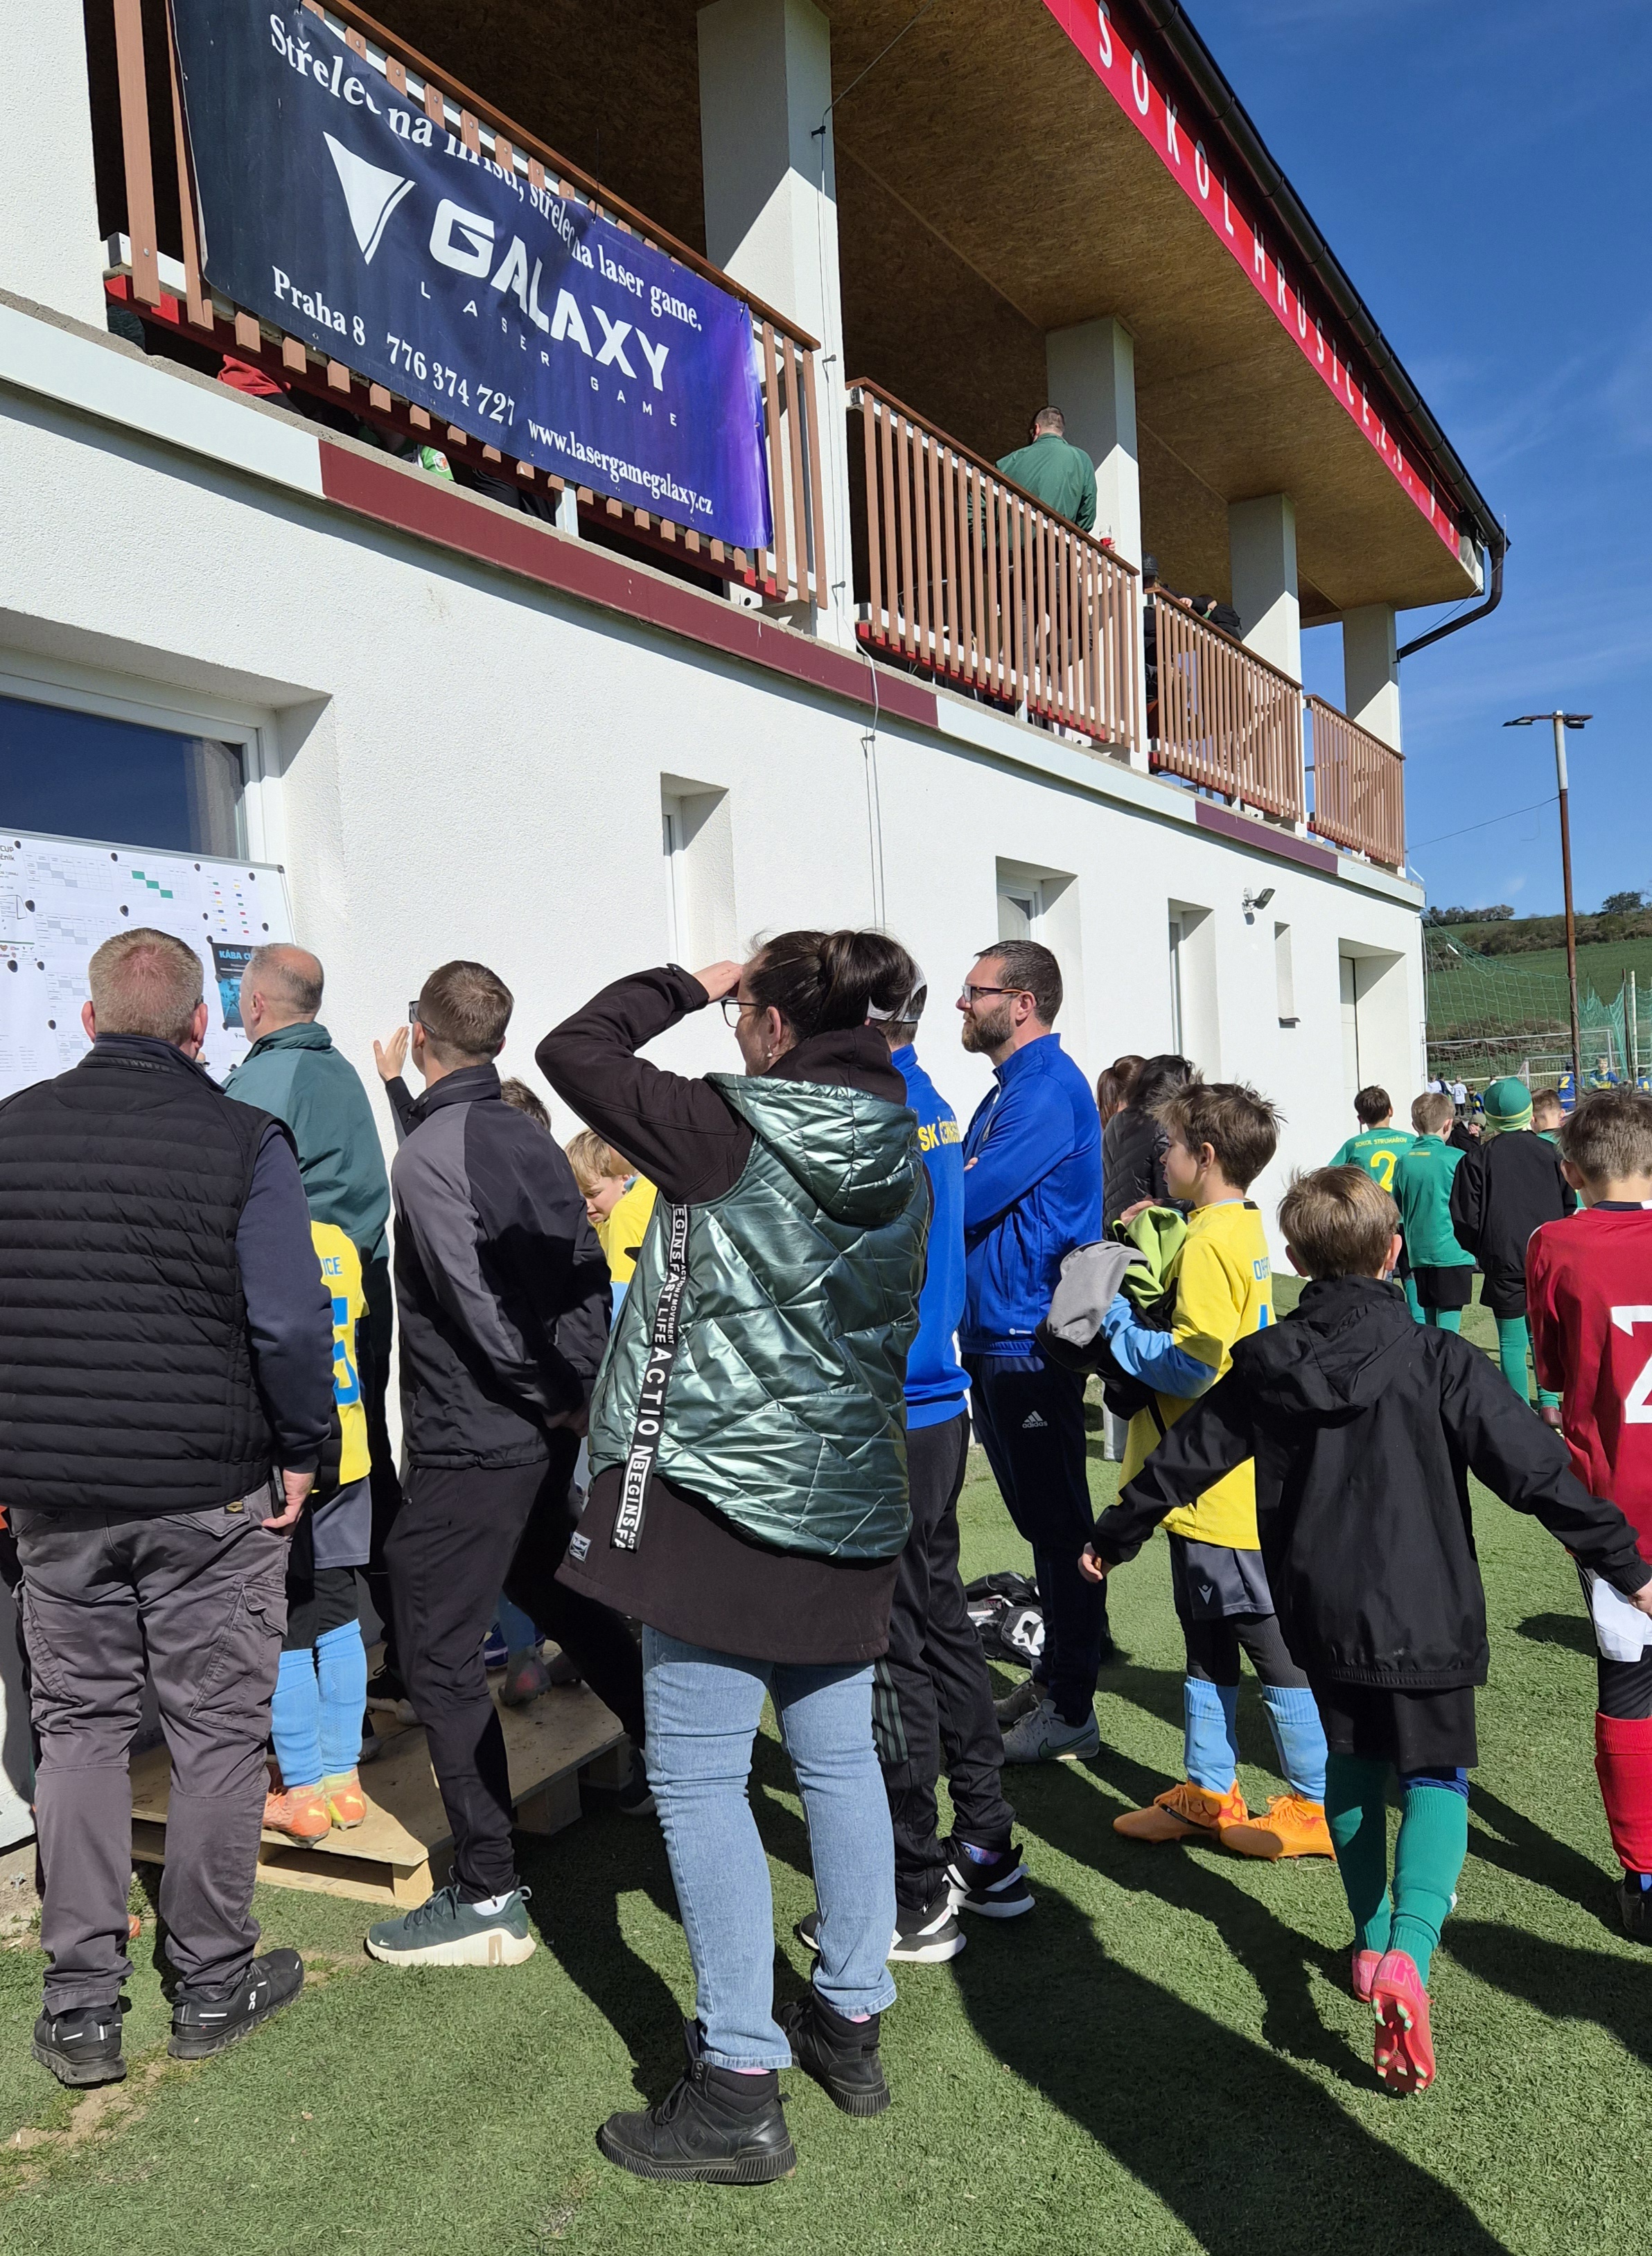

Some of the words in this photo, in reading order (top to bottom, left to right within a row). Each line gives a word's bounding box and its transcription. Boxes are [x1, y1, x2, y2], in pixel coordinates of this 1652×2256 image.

[387, 107, 433, 147] na
[1098, 0, 1234, 238] SOKOL
[272, 265, 347, 336] Praha
[353, 315, 366, 346] 8
[429, 198, 669, 392] GALAXY
[571, 236, 595, 270] na
[597, 243, 644, 299] laser
[650, 285, 703, 333] game.
[387, 331, 428, 380] 776
[432, 362, 471, 407] 374
[476, 383, 516, 427] 727
[420, 281, 551, 367] LASER
[590, 376, 678, 427] GAME
[527, 418, 714, 516] www.lasergamegalaxy.cz
[218, 949, 243, 960] KÁBA
[1560, 1075, 1570, 1089] 2
[917, 1123, 940, 1152] SK
[1355, 1140, 1373, 1149] SOKOL
[1370, 1149, 1398, 1192] 2
[660, 1262, 681, 1303] FAST
[655, 1307, 669, 1344] LIFE
[633, 1347, 672, 1459] ACTION
[1022, 1420, 1048, 1429] adidas
[622, 1457, 649, 1527] BEGINS
